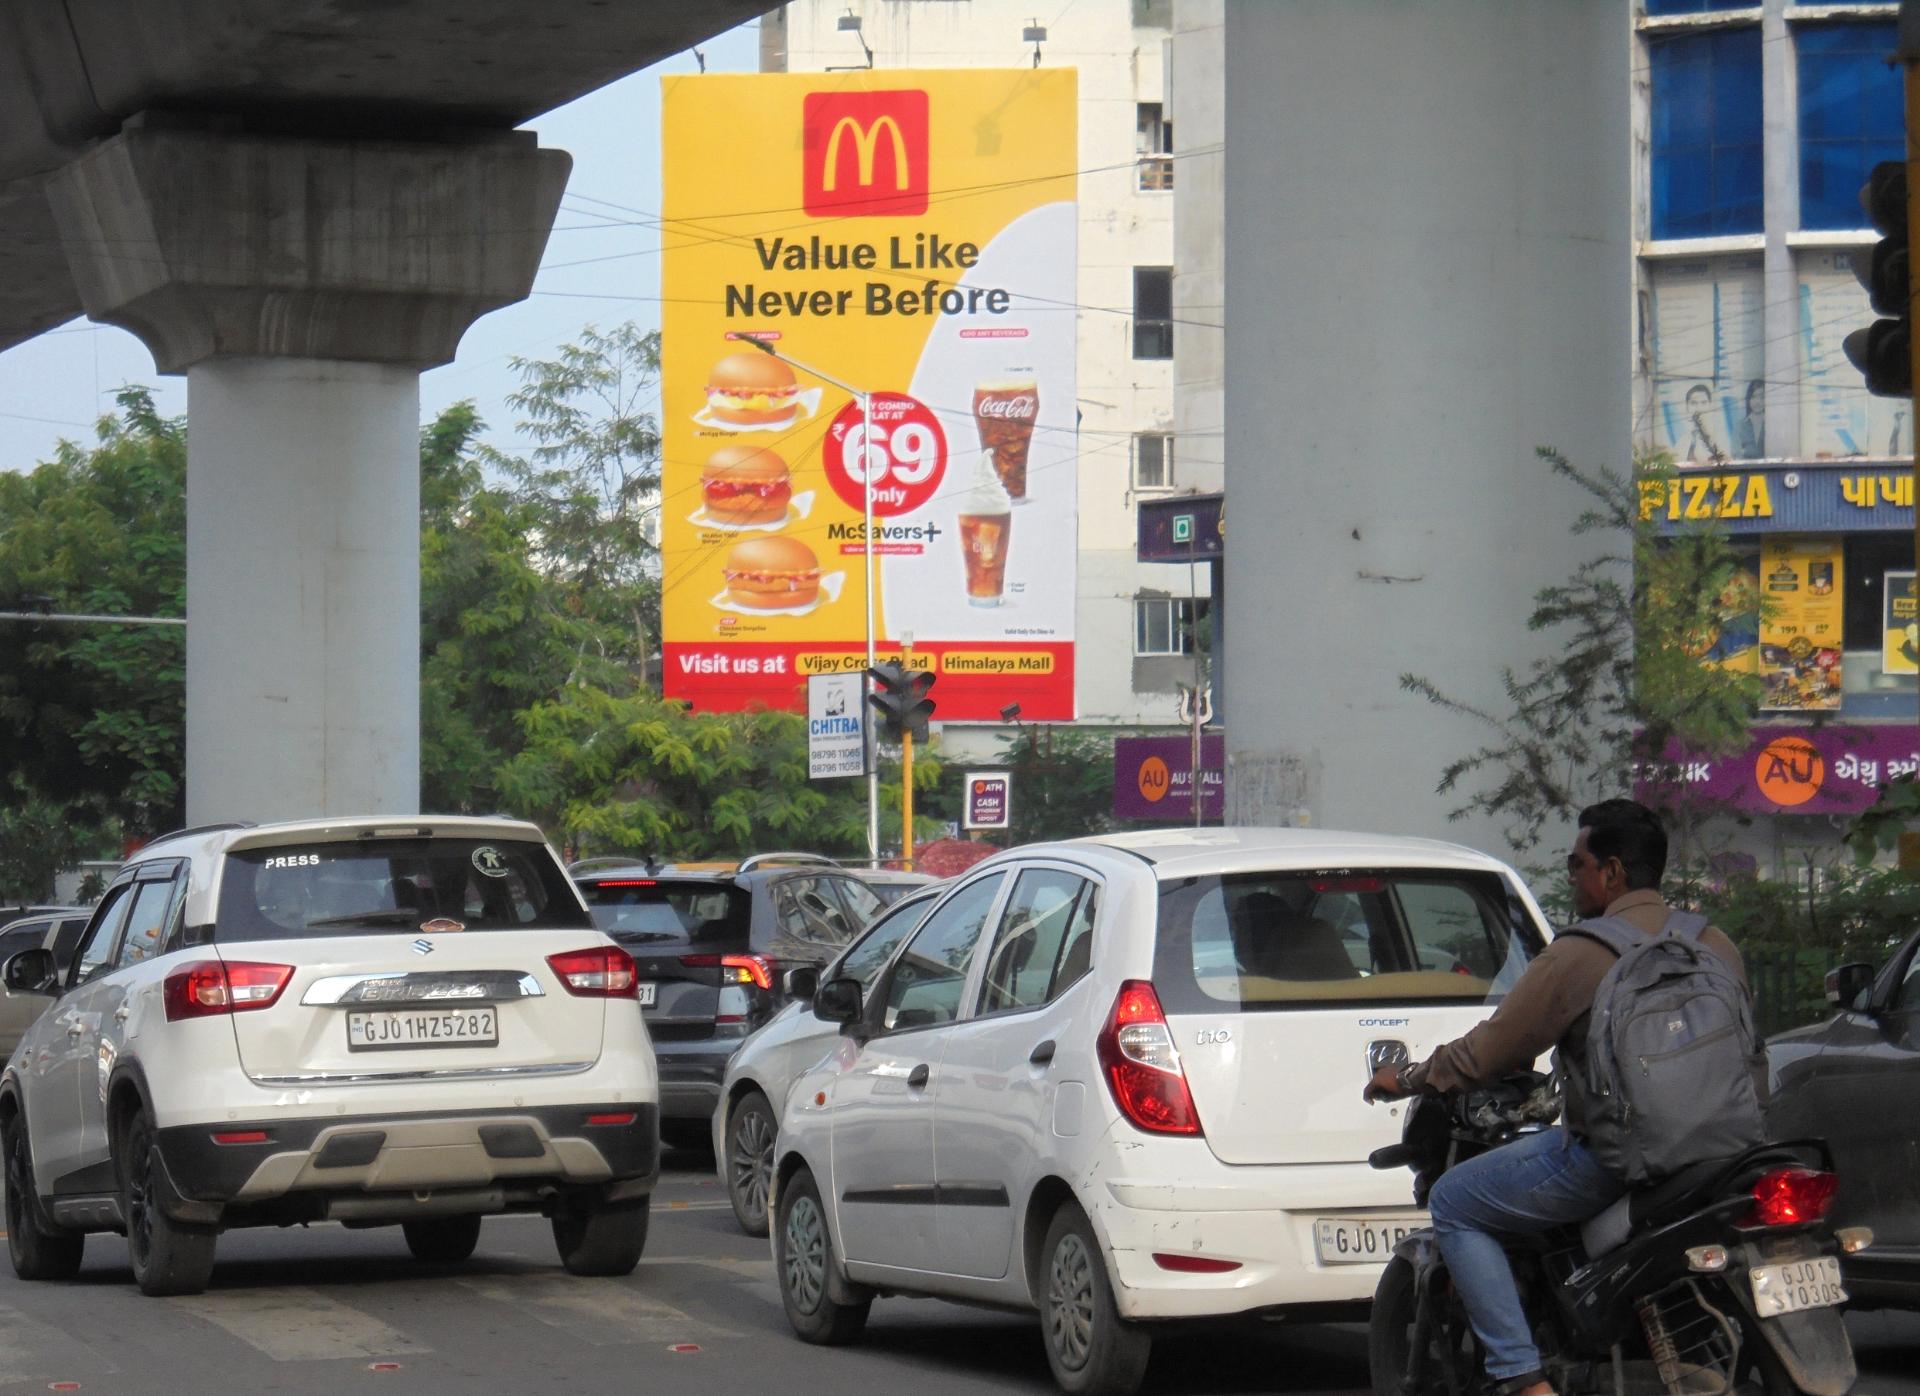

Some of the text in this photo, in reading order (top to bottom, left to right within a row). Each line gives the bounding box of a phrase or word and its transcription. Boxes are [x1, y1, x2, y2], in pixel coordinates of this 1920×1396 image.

[753, 232, 979, 271] Value Like
[725, 279, 1010, 318] Never Before
[878, 401, 915, 411] COMBO
[892, 411, 904, 420] AT
[1637, 474, 1774, 521] PIZZA
[679, 653, 786, 674] Visit us at
[803, 655, 840, 673] Vijay
[944, 656, 1050, 673] Himalaya Mall
[811, 717, 859, 735] CHITRA
[811, 749, 837, 760] 98796
[811, 761, 860, 773] 98796 11058
[1763, 757, 1813, 784] AU
[1142, 769, 1165, 787] AU
[1171, 772, 1223, 785] AU SALL
[985, 783, 1003, 792] ATM
[976, 798, 999, 807] CASH
[265, 854, 320, 869] PRESS
[365, 1014, 492, 1042] GJ01HZ5282
[1359, 1018, 1410, 1027] CONCEPT
[1781, 1262, 1826, 1286] GJ01
